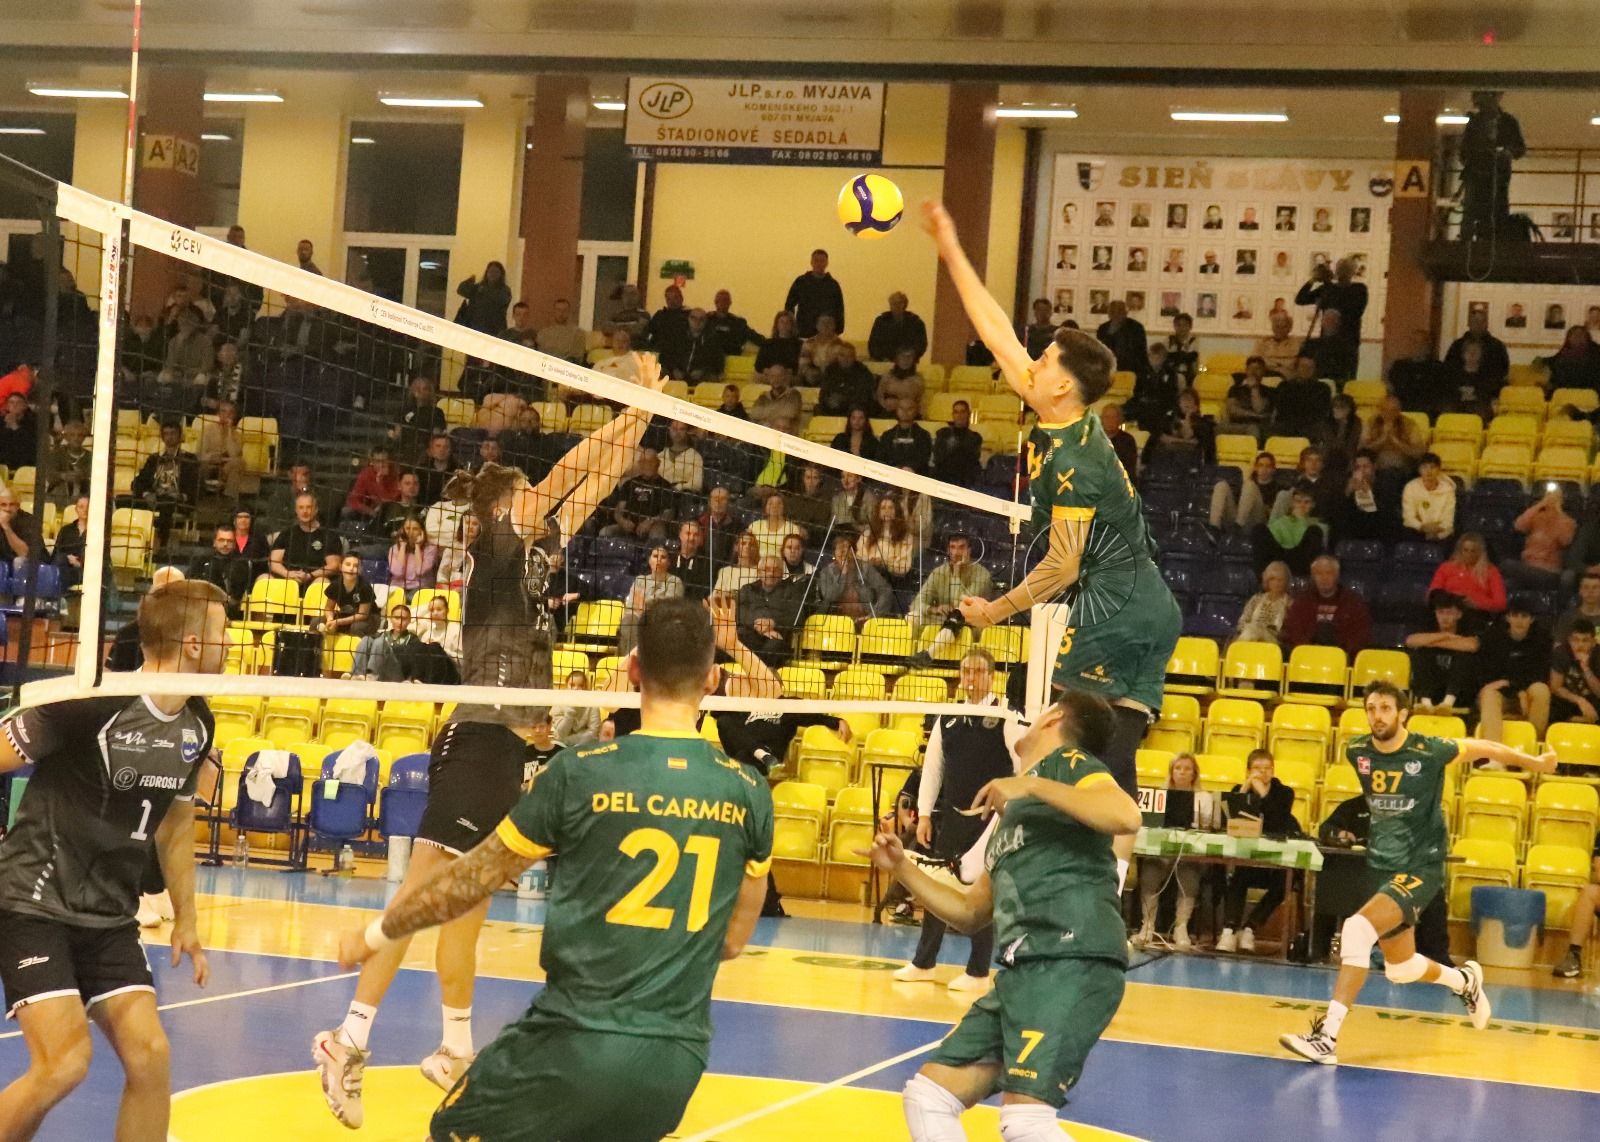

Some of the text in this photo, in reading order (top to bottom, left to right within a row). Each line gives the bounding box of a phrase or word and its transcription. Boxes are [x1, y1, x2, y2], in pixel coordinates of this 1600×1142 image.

[648, 91, 685, 113] JLP
[803, 85, 872, 100] MYJAVA
[657, 124, 848, 145] ŠTADIONOVÉ SEDADLÁ
[1402, 165, 1425, 193] A
[183, 238, 202, 255] CEV
[138, 775, 177, 790] FEDROSA
[1371, 770, 1404, 794] 87
[130, 799, 153, 841] 1
[592, 791, 747, 826] DEL CARMEN
[605, 827, 721, 932] 21
[1016, 1030, 1045, 1063] 7
